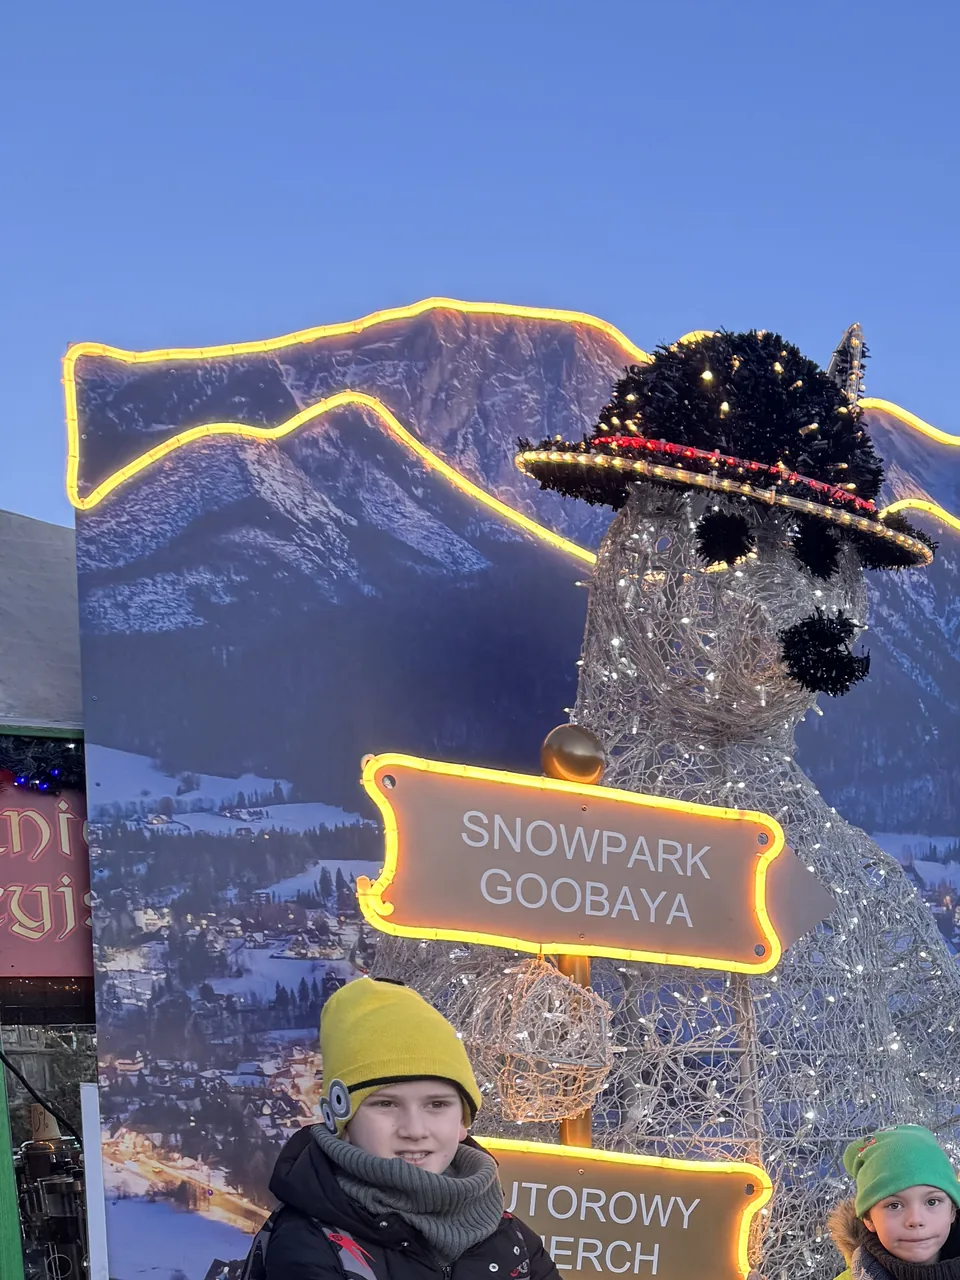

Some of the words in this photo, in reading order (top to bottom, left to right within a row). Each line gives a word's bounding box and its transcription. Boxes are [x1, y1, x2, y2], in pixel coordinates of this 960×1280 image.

[0, 800, 88, 860] ni
[461, 810, 711, 879] SNOWPARK
[0, 874, 92, 940] yj
[480, 868, 694, 928] GOOBAYA
